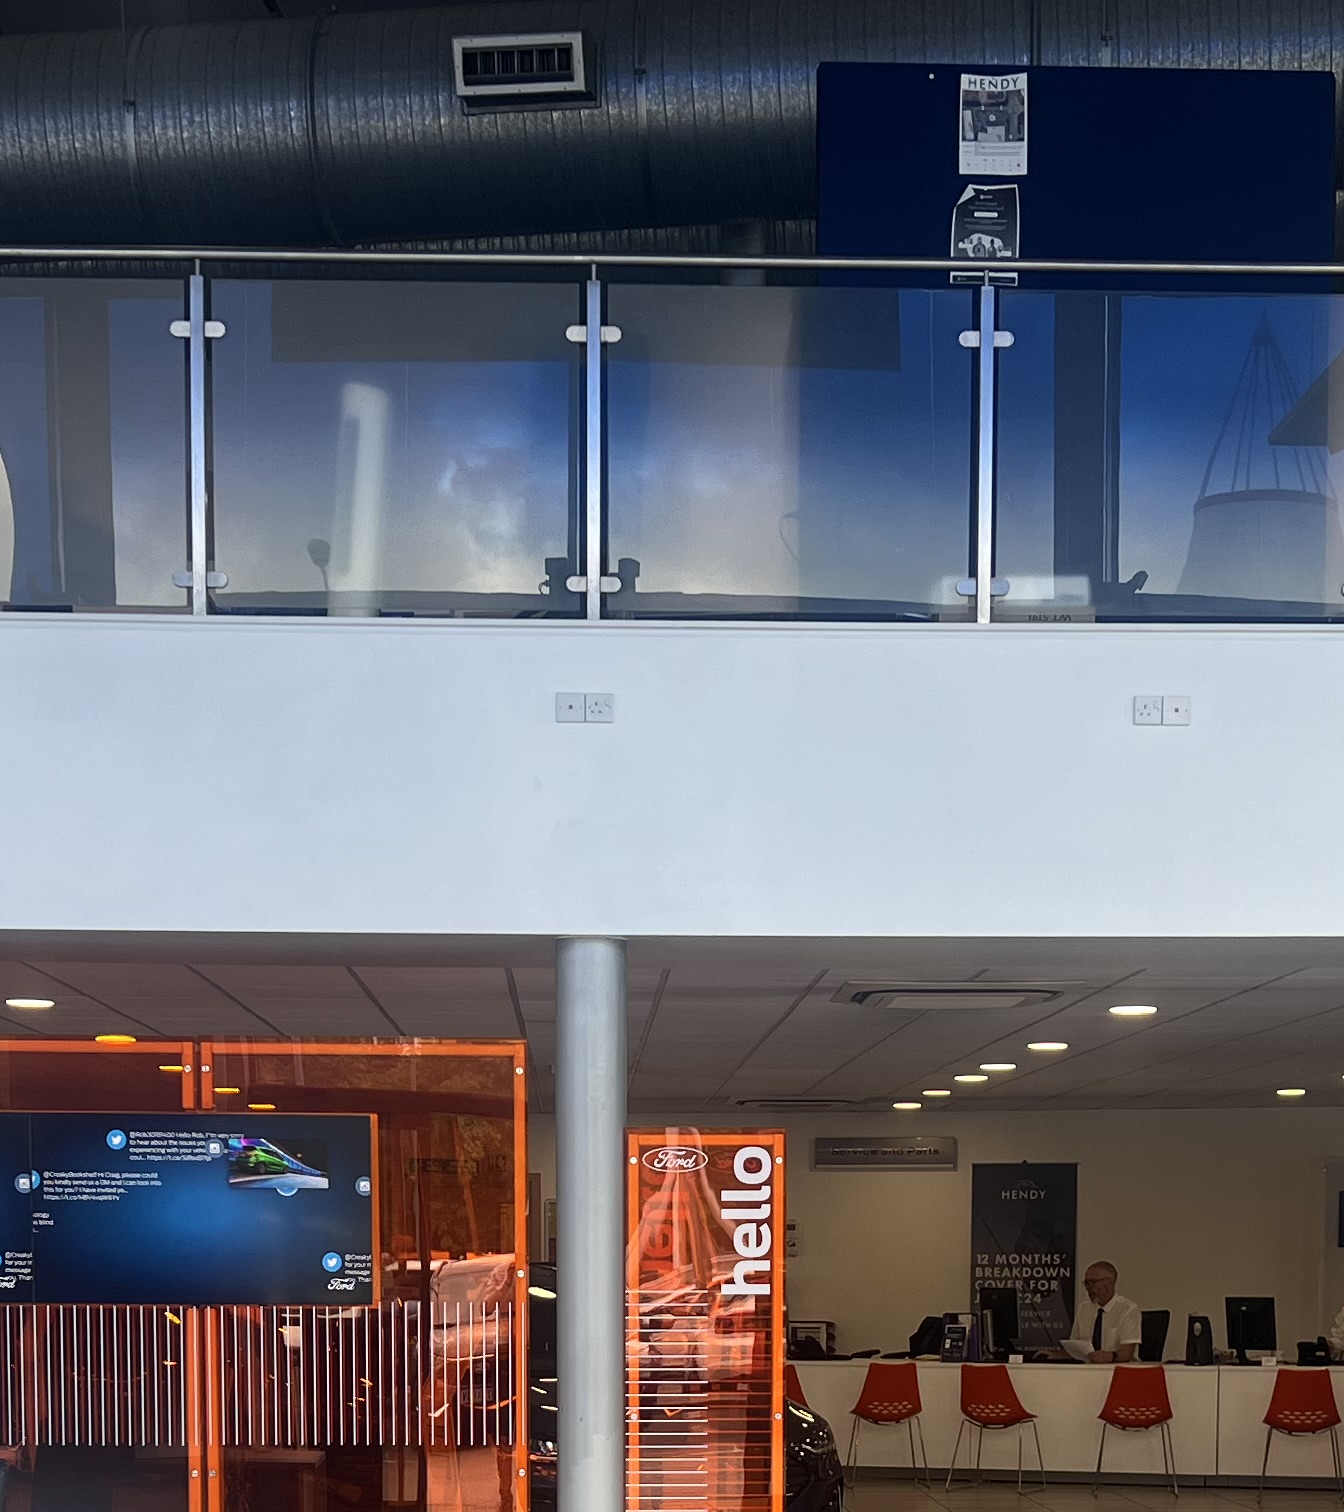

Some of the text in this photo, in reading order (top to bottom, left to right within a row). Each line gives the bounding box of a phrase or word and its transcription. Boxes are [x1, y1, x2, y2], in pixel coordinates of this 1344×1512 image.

[968, 77, 1019, 90] HENDY
[830, 1147, 878, 1156] Service
[907, 1147, 940, 1156] Parts
[654, 1150, 696, 1168] Ford
[1001, 1190, 1046, 1200] HENDY
[721, 1146, 772, 1295] hello
[977, 1254, 989, 1264] 12
[976, 1267, 1070, 1278] BREAKDOWN
[327, 1278, 356, 1290] Ford
[975, 1280, 1058, 1290] COVER FOR
